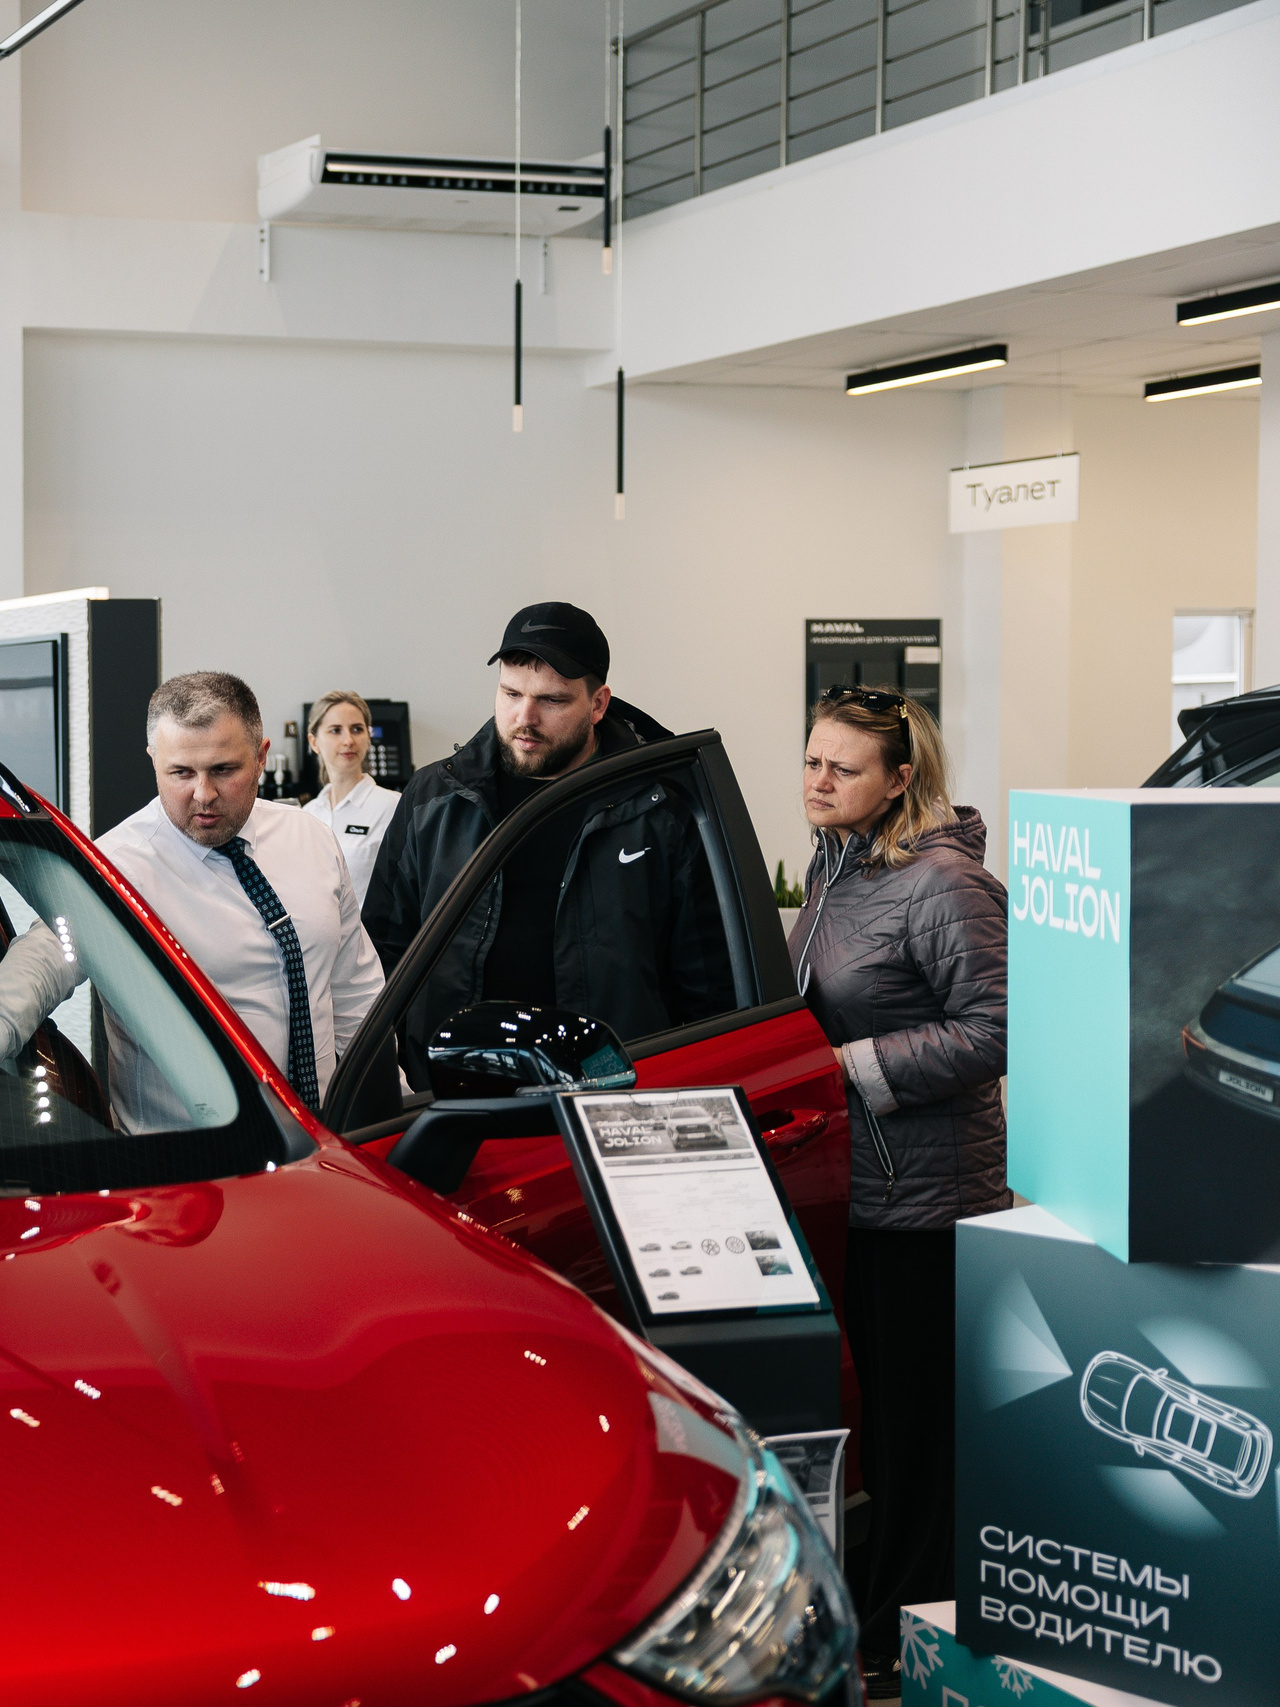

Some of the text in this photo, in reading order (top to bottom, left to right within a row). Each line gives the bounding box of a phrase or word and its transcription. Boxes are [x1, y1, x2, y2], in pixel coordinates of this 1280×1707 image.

[965, 479, 1061, 512] Туалет
[810, 623, 864, 633] HAVAL
[1013, 820, 1102, 880] HAVAL
[1013, 874, 1120, 944] JOLION
[599, 1126, 651, 1138] HAVAL
[604, 1135, 662, 1149] JOLION
[980, 1525, 1189, 1600] СИСТЕМЫ
[980, 1560, 1170, 1632] ПОМОЩИ
[980, 1595, 1223, 1684] ВОДИТЕЛЮ
